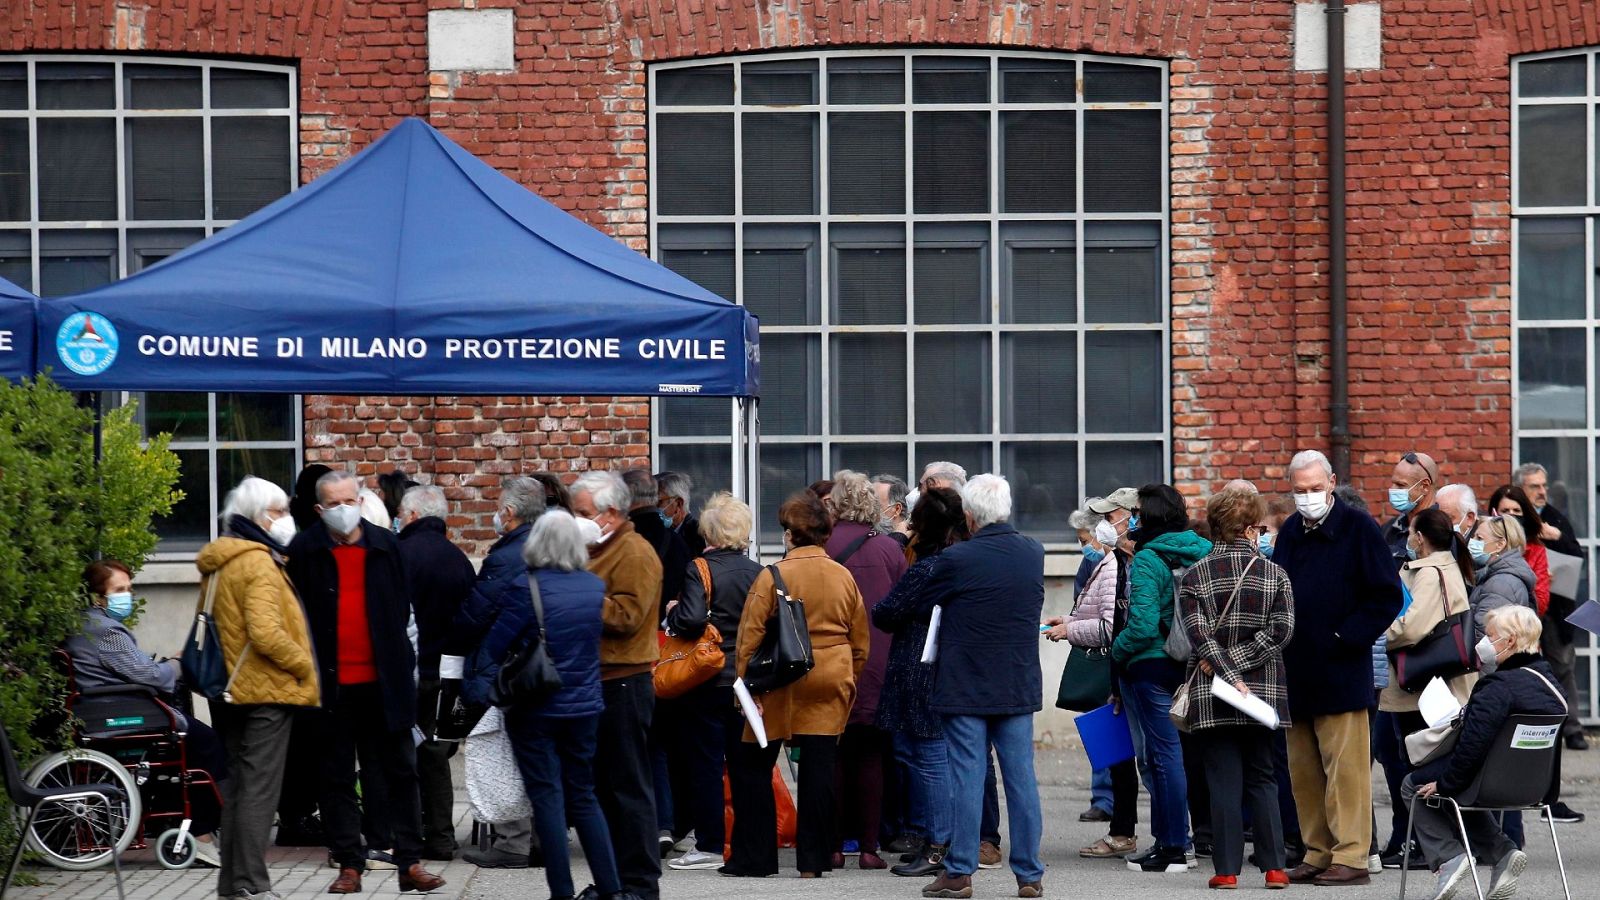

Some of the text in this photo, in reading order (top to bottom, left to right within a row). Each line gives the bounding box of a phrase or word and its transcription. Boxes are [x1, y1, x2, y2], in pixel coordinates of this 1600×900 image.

[137, 334, 259, 357] COMUNE
[276, 337, 304, 358] DI
[321, 337, 428, 359] MILANO
[445, 338, 620, 359] PROTEZIONE
[638, 338, 726, 360] CIVILE
